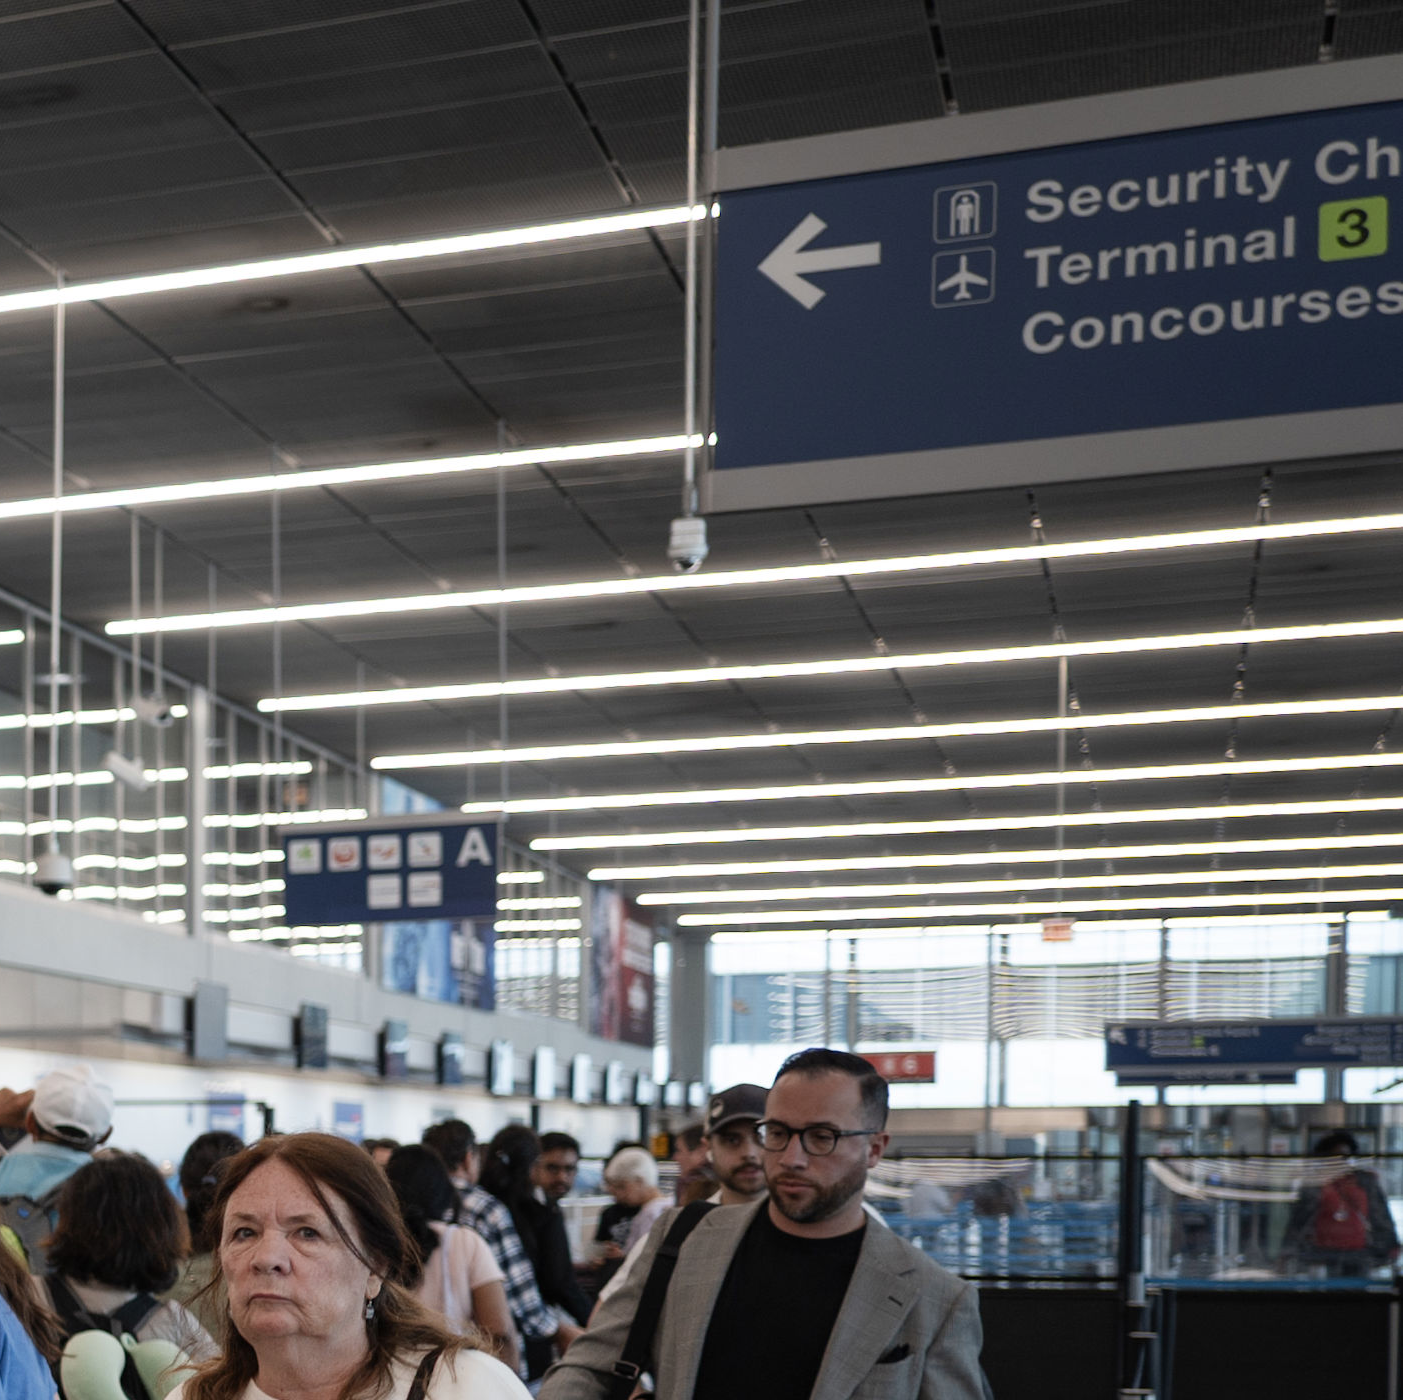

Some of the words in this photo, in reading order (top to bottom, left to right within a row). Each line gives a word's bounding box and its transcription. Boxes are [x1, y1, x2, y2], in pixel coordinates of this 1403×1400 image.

[1025, 155, 1291, 223] Security
[1315, 137, 1401, 186] Ch
[1024, 216, 1296, 288] Terminal
[1335, 208, 1370, 249] 3
[1022, 280, 1403, 354] Concourses
[455, 826, 492, 868] A
